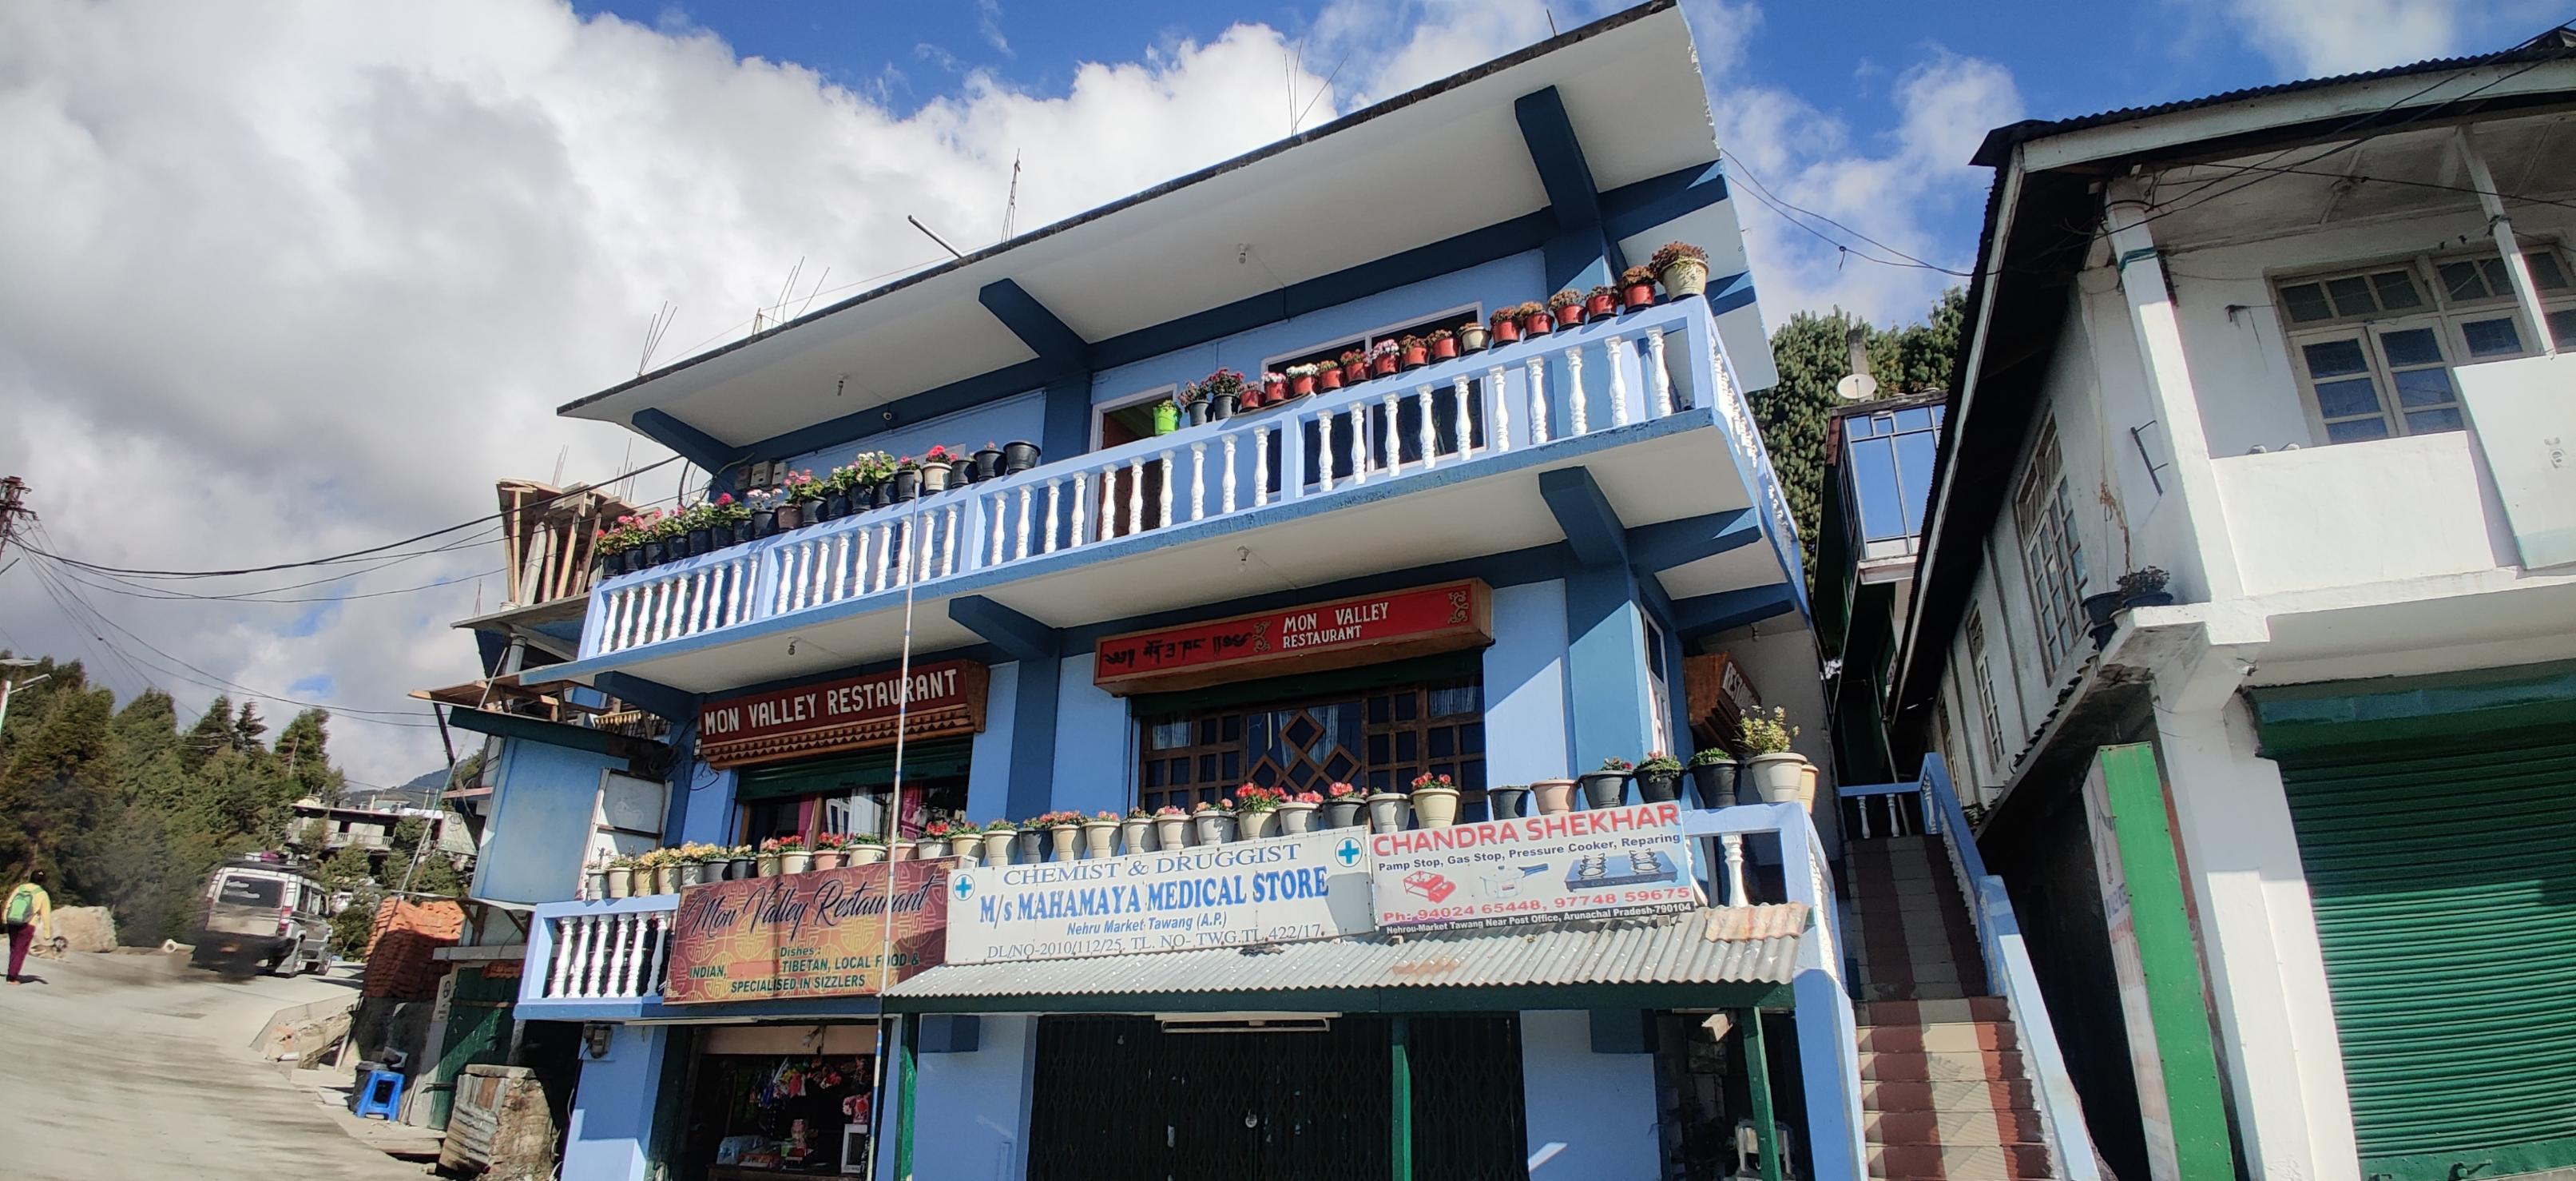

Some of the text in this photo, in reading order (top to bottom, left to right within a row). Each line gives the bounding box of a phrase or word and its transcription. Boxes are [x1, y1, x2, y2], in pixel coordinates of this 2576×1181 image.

[1284, 602, 1388, 633] MON VALLEY
[1283, 626, 1362, 648] RESTAURANT
[705, 669, 957, 735] MON VALLEY RESTAURANT
[1373, 804, 1678, 857] CHANDRA SHEKHAR
[1004, 844, 1301, 885] CHEMIST & DRUGGIST
[1379, 833, 1681, 872] Pamp Stop, Gas Stop, Pressure Cooker, Reparing
[687, 874, 939, 941] Mon Valley Restaurant
[979, 865, 1329, 928] M/s MAHAMAYA MEDICAL STORE
[1383, 887, 1691, 922] Ph: 94024 65448, 97748 59675
[1067, 911, 1228, 936] Nehru Market Tawang (A.P.)
[1450, 920, 1483, 930] Tawang
[1486, 917, 1506, 927] Near
[1509, 915, 1530, 925] Post
[1531, 913, 1562, 924] Office,
[1563, 909, 1611, 921] Arunachal
[1613, 903, 1691, 917] Pradesh-790104
[689, 964, 727, 980] INDIAN,
[782, 958, 832, 973] TIBETAN,
[835, 956, 871, 970] LOCAL
[911, 952, 921, 965] &
[731, 974, 865, 993] SPECIALISED IN SIZZLERS
